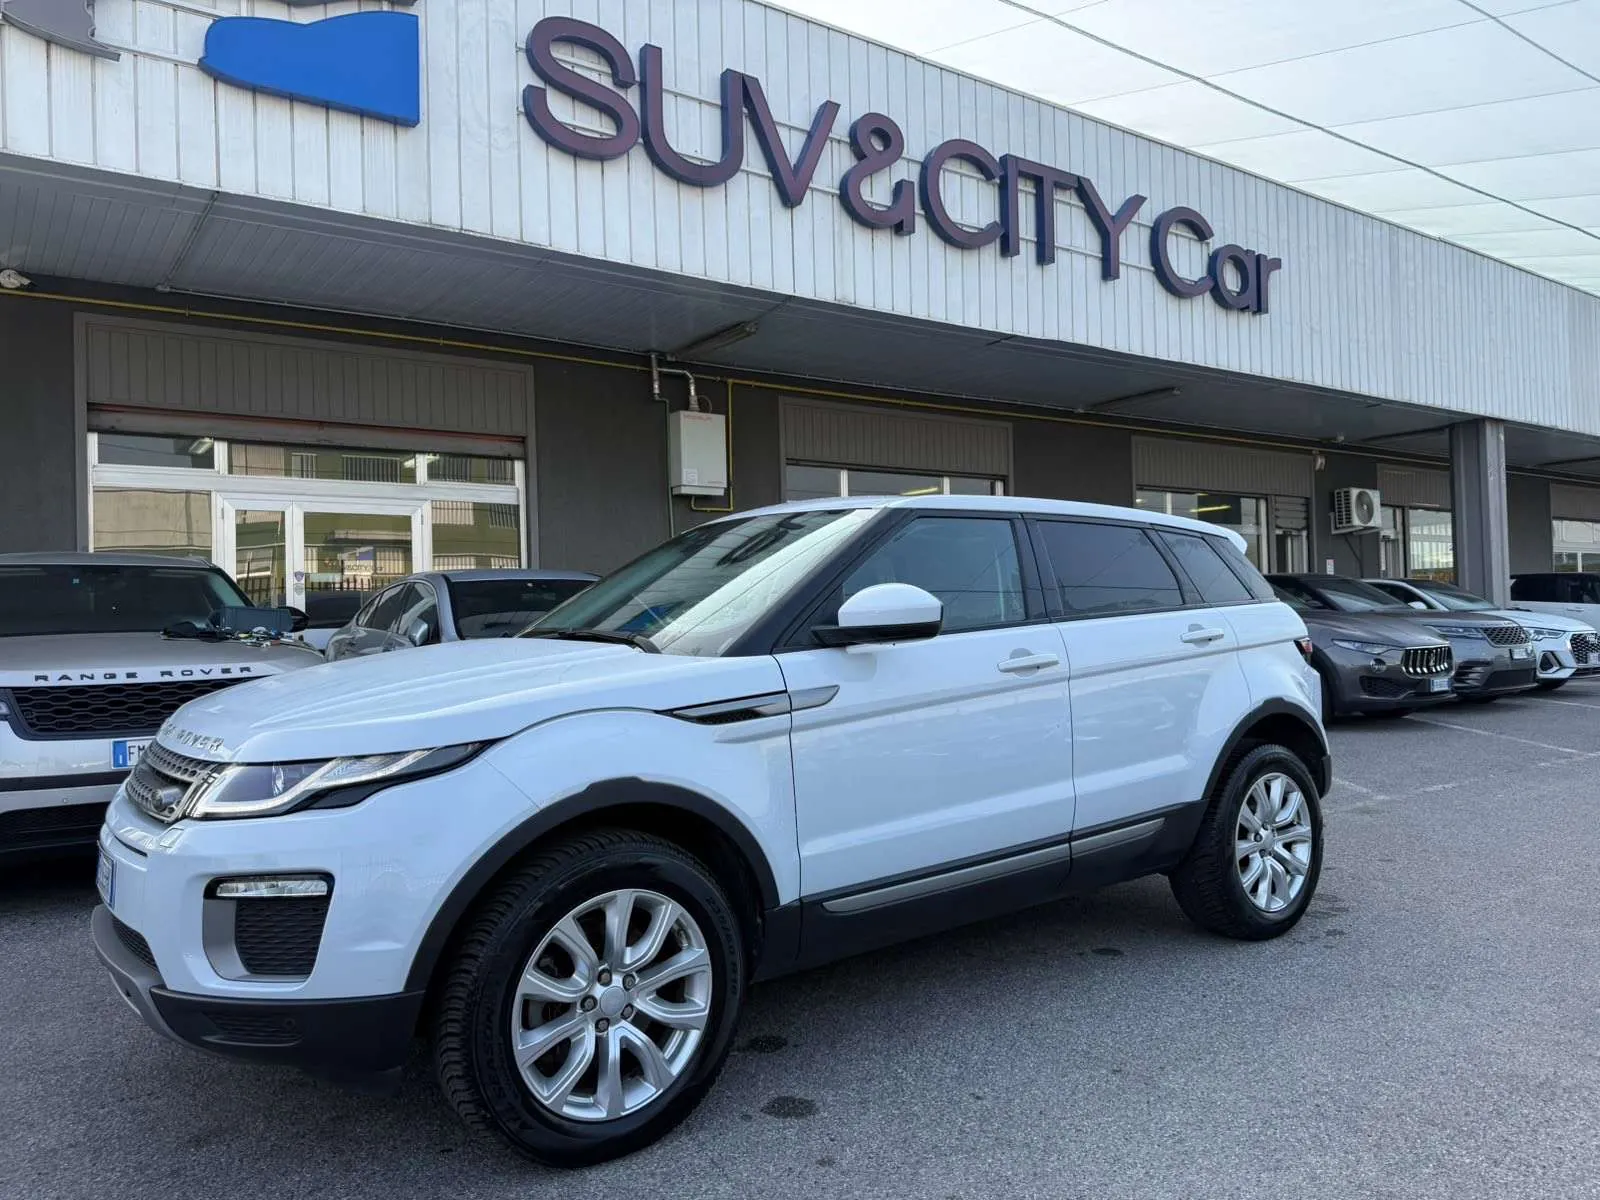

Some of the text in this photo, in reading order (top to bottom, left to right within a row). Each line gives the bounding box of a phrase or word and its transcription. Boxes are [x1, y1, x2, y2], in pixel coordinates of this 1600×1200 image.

[1150, 206, 1281, 315] Car
[34, 666, 252, 682] RANGE ROVER
